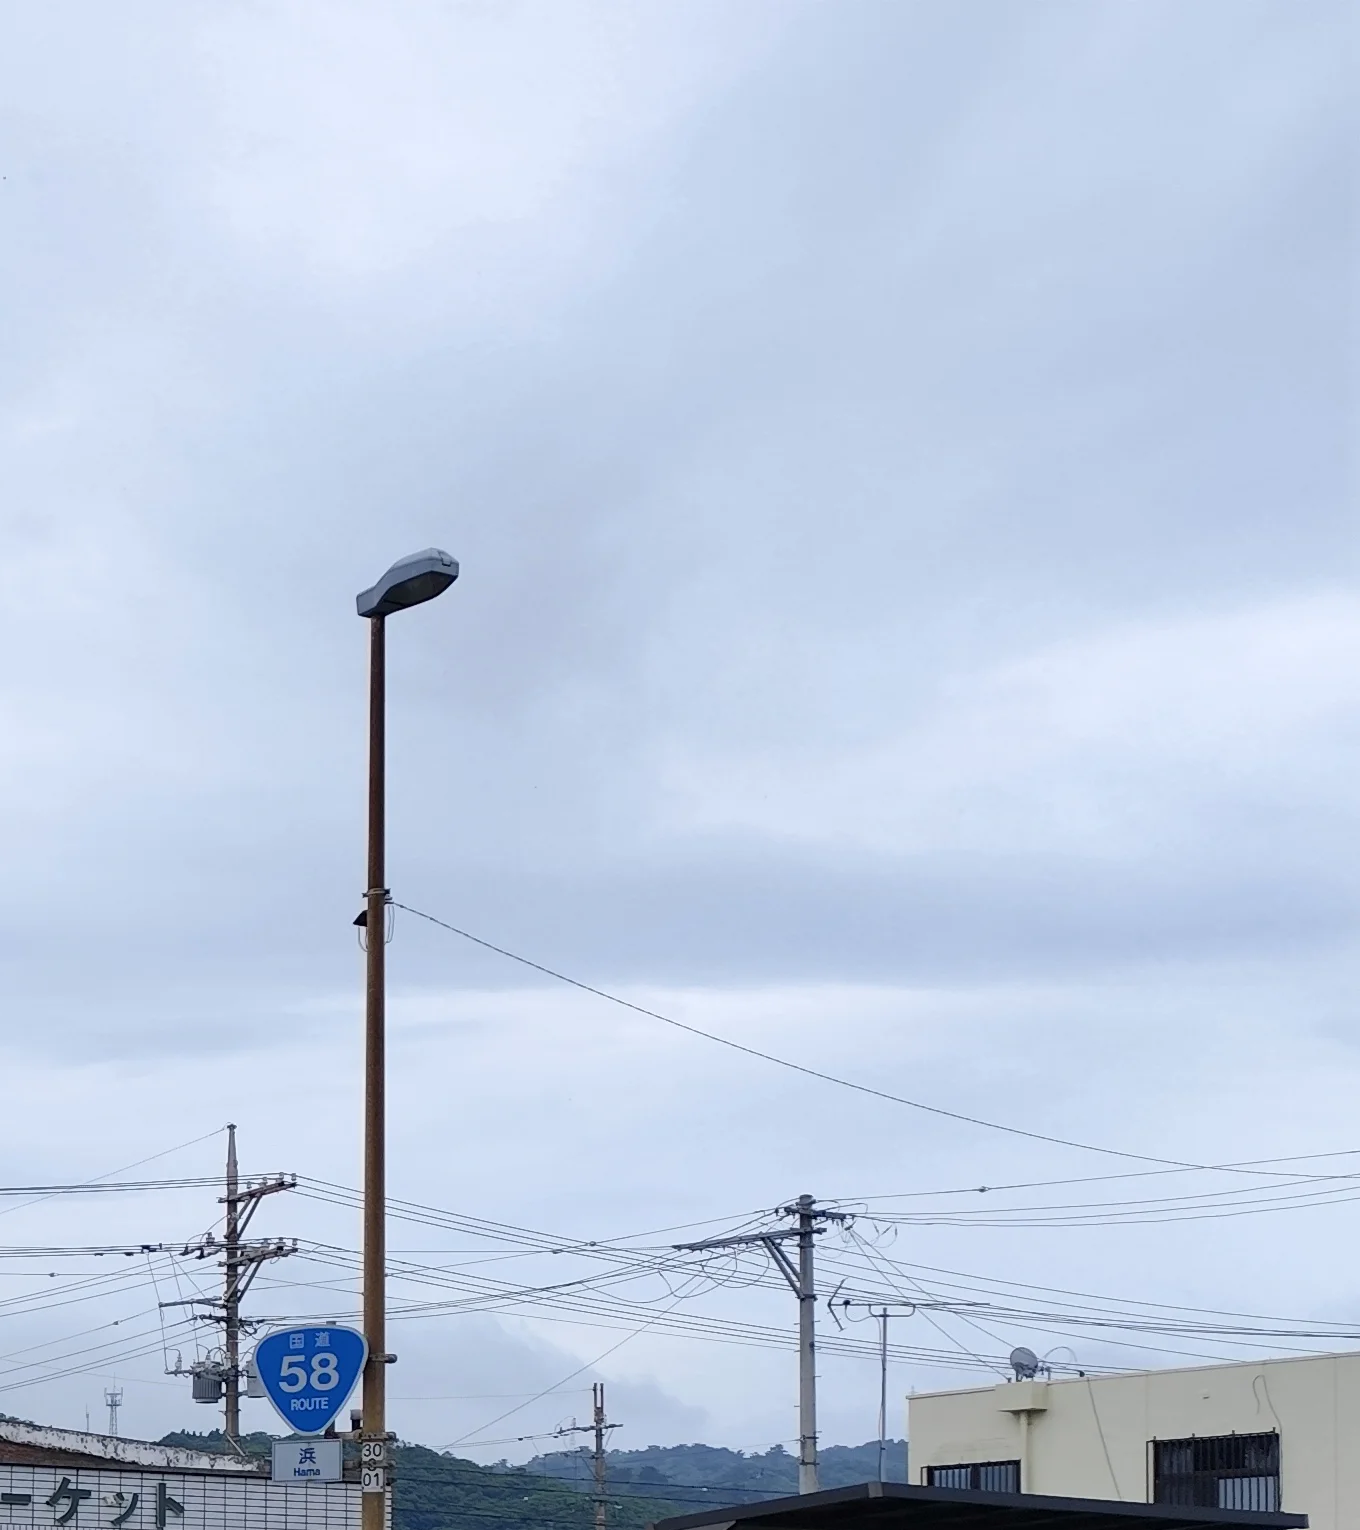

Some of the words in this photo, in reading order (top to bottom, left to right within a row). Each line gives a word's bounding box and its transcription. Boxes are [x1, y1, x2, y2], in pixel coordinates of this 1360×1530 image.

[289, 1331, 331, 1349] 国道
[278, 1352, 340, 1393] 58
[290, 1397, 329, 1411] ROUTE
[298, 1447, 316, 1465] 浜
[363, 1443, 382, 1457] 30
[293, 1467, 321, 1477] Hama
[363, 1472, 380, 1486] 01
